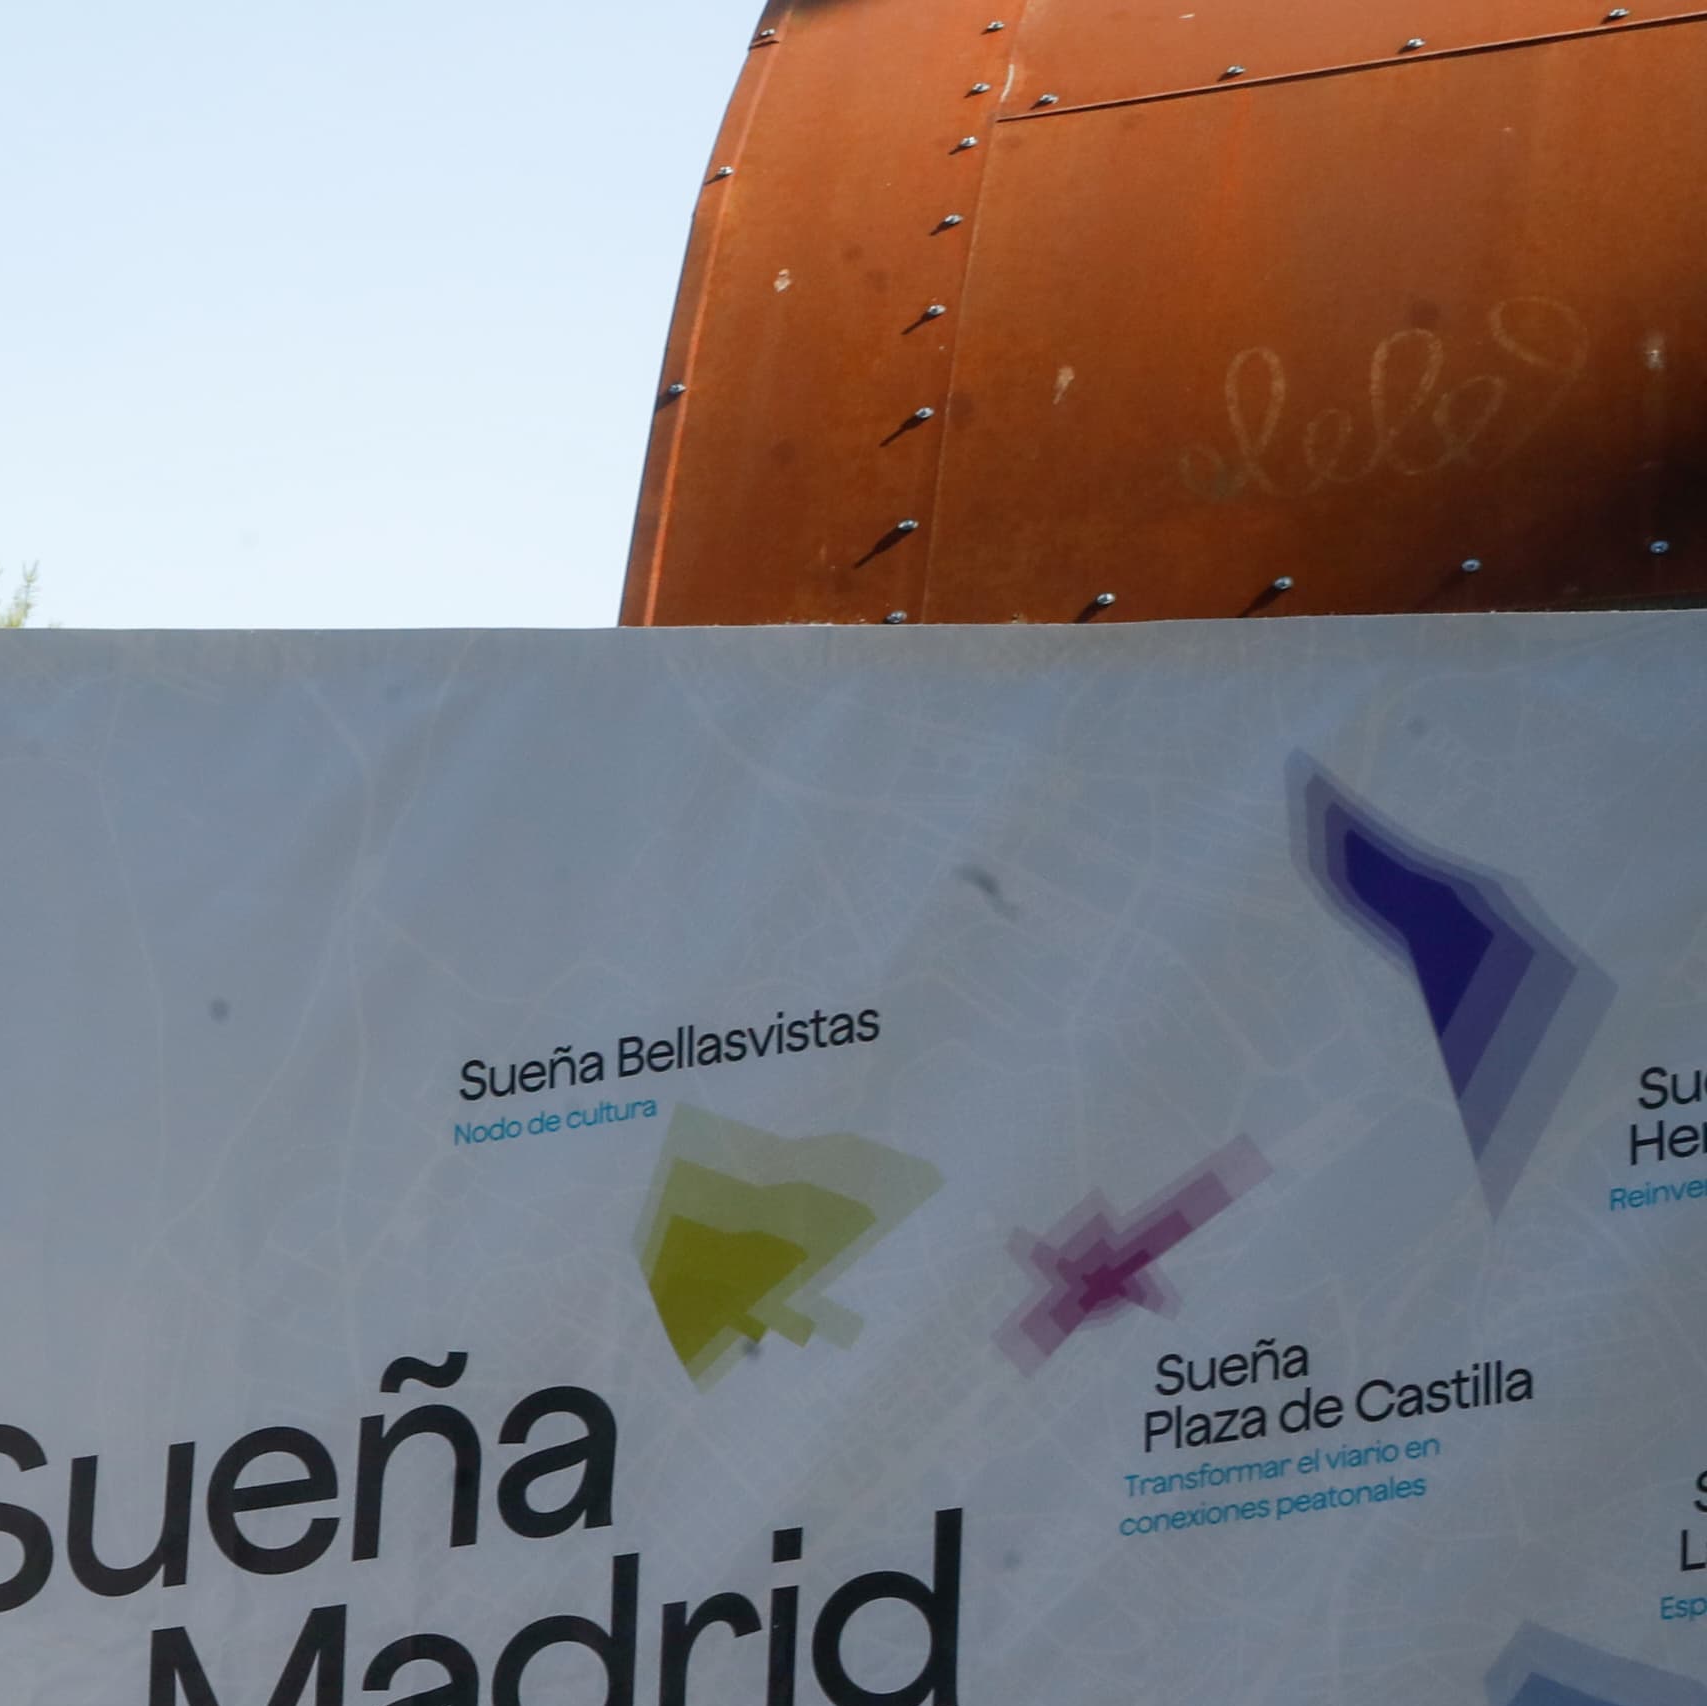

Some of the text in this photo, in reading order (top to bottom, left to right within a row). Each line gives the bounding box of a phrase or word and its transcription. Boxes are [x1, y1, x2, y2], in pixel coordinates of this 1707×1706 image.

[459, 1008, 880, 1101] Sueña Bellasvistas
[1638, 1066, 1707, 1110] Su
[454, 1098, 658, 1146] Nodo de cultura
[1630, 1120, 1707, 1166] He
[1610, 1178, 1707, 1211] Reinve
[1155, 1338, 1309, 1395] Sueña
[1143, 1360, 1534, 1453] Plaza de Castilla
[1123, 1434, 1440, 1498] Transformar el viario en
[1119, 1475, 1427, 1537] conexiones peatonales
